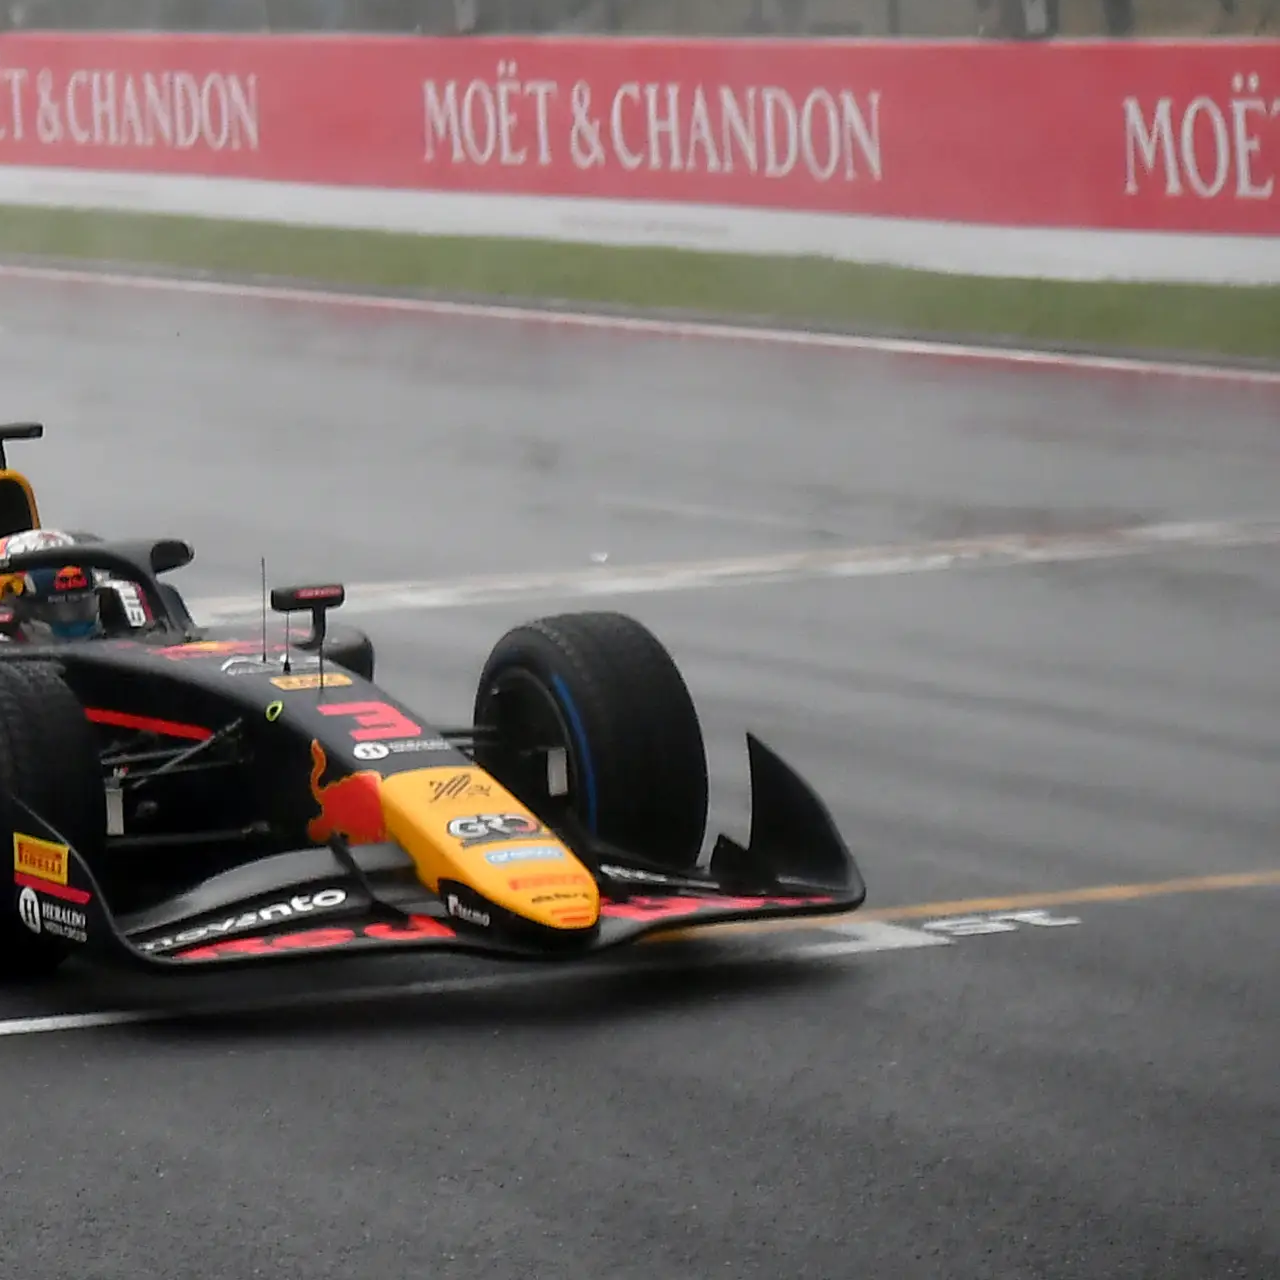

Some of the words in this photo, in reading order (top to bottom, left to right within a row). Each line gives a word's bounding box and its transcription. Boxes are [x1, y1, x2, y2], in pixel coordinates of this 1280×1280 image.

[38, 68, 61, 145] &
[65, 69, 260, 152] CHANDON
[423, 59, 557, 166] MOËT
[571, 78, 606, 170] &
[610, 81, 882, 182] CHANDON
[1122, 71, 1280, 199] MOË
[317, 700, 422, 742] 3
